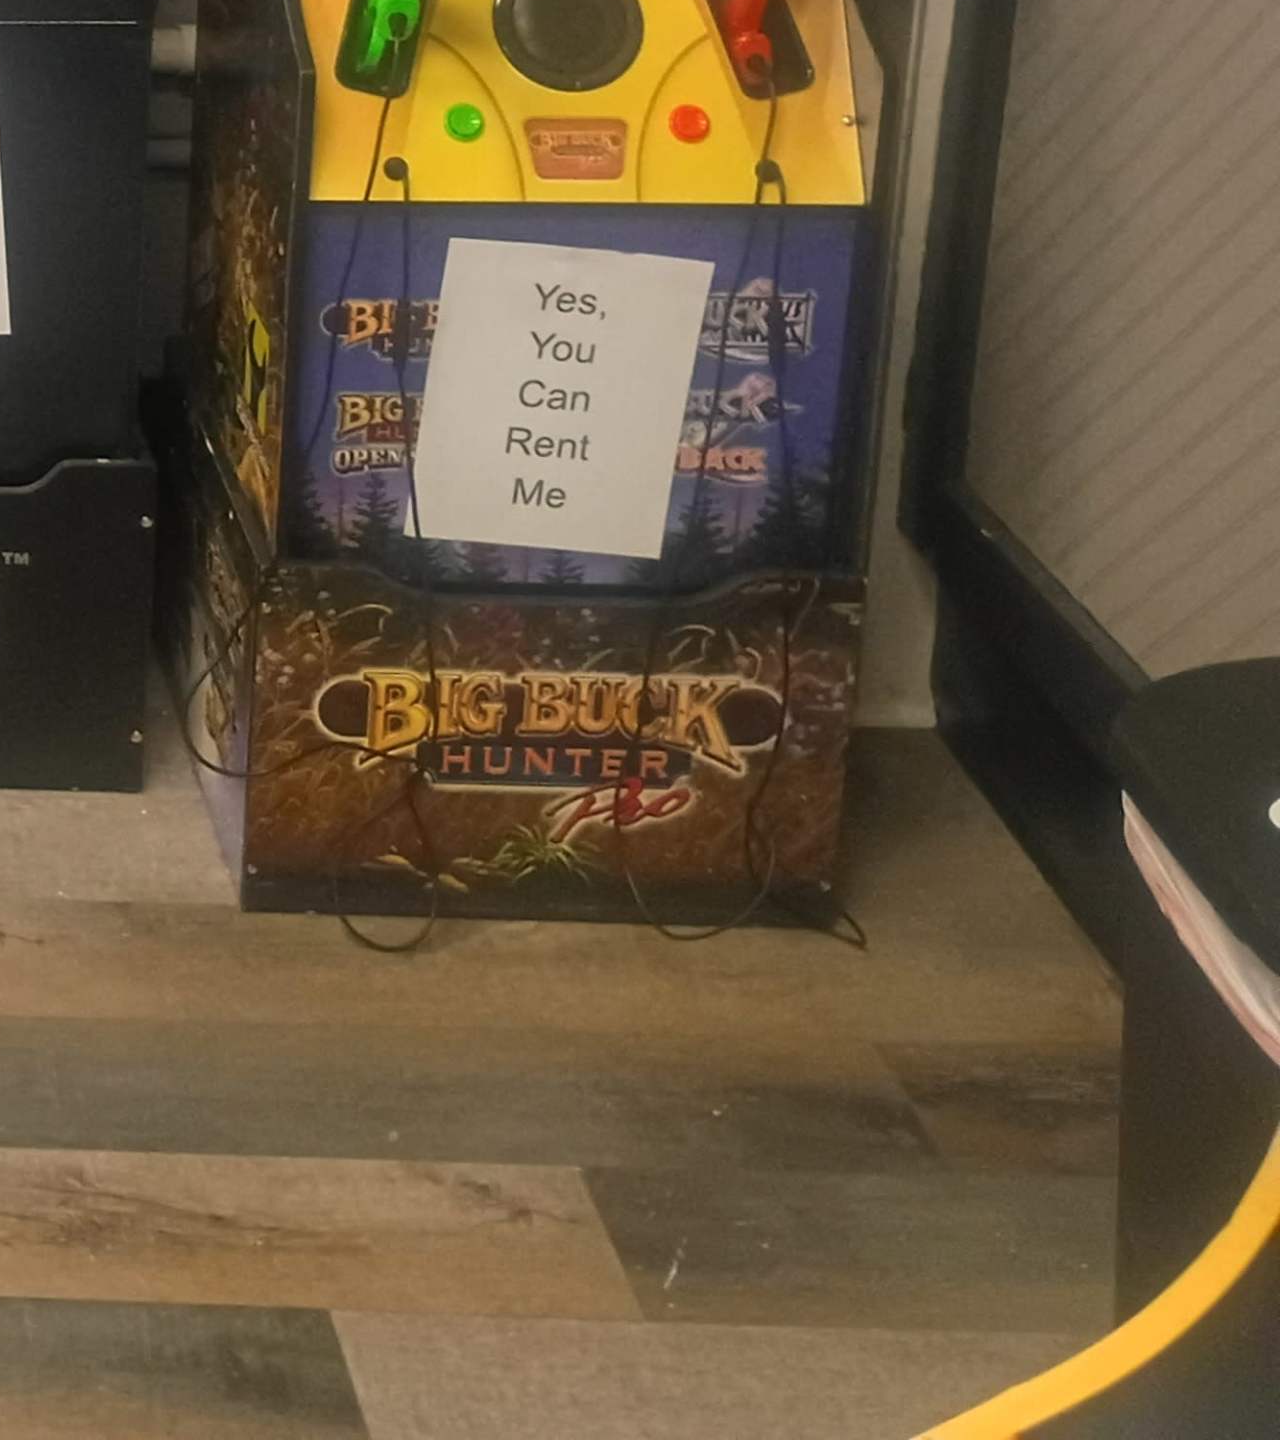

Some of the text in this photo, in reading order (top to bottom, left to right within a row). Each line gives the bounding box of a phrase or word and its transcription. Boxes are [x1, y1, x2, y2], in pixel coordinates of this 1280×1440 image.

[534, 282, 607, 321] Yes,
[530, 331, 596, 365] You
[519, 379, 591, 413] Can
[339, 395, 405, 434] BIG
[333, 448, 406, 472] OPEN
[506, 426, 590, 463] Rent
[512, 477, 566, 510] Me
[357, 669, 746, 775] BIG BUCK
[441, 746, 671, 779] HUNTER
